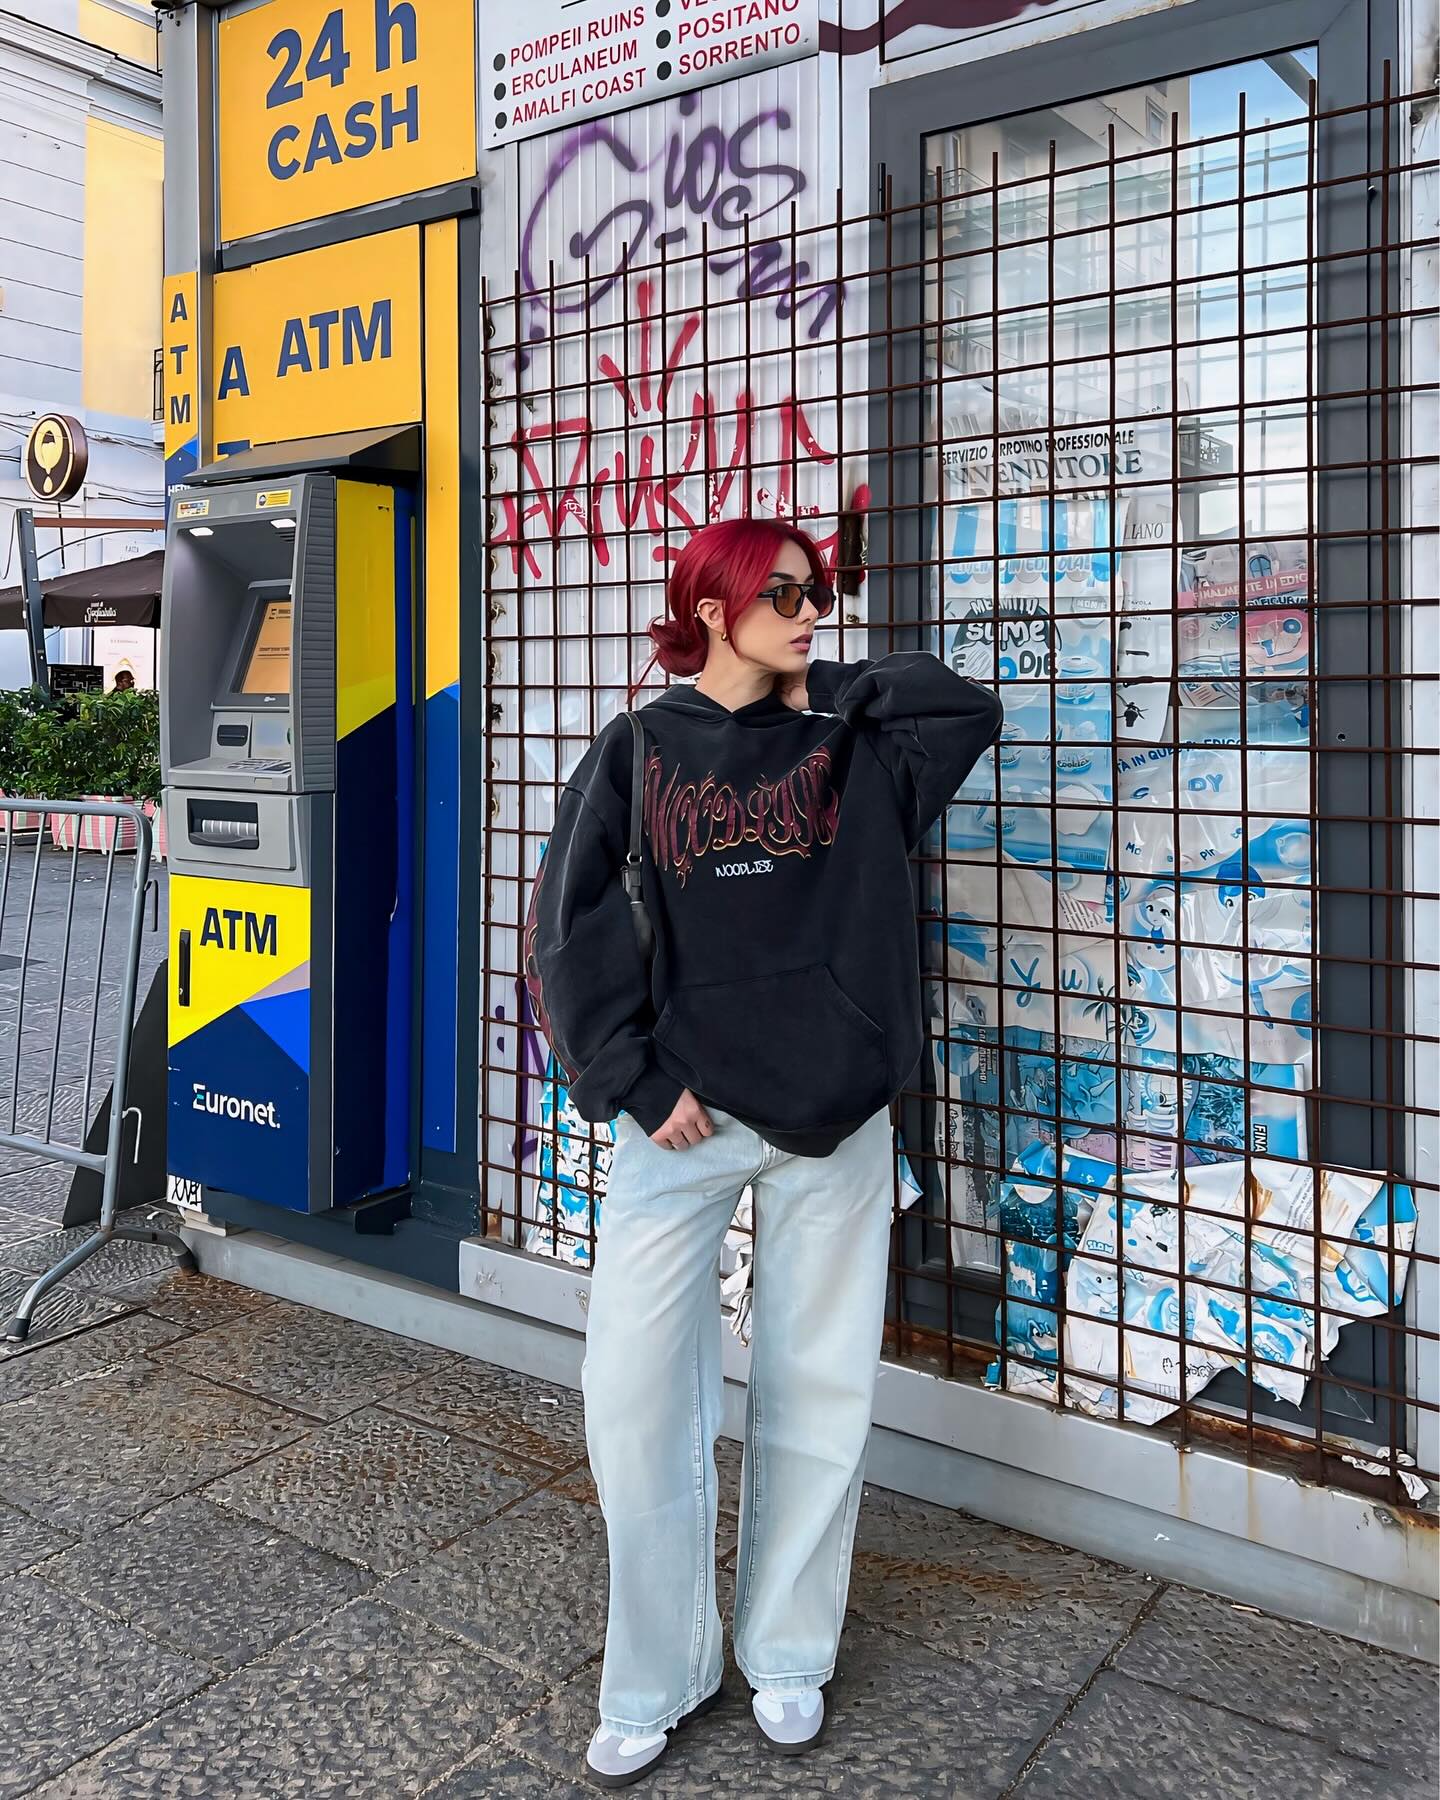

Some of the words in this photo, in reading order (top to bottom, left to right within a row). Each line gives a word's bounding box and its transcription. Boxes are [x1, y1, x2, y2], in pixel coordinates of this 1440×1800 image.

[511, 28, 582, 67] POMPEII
[587, 6, 645, 42] RUINS
[678, 0, 799, 44] POSITANO
[679, 23, 800, 75] SORRENTO
[266, 9, 350, 109] 24
[375, 0, 417, 72] h
[512, 40, 638, 96] ERCULANEUM
[512, 88, 576, 126] AMALFI
[582, 68, 647, 104] COAST
[268, 85, 418, 180] CASH
[170, 293, 190, 424] ATM
[277, 299, 392, 378] ATM
[942, 446, 988, 466] SERVIZIO
[991, 439, 1043, 457] RROTINO
[1131, 754, 1146, 768] IN
[200, 906, 278, 956] ATM
